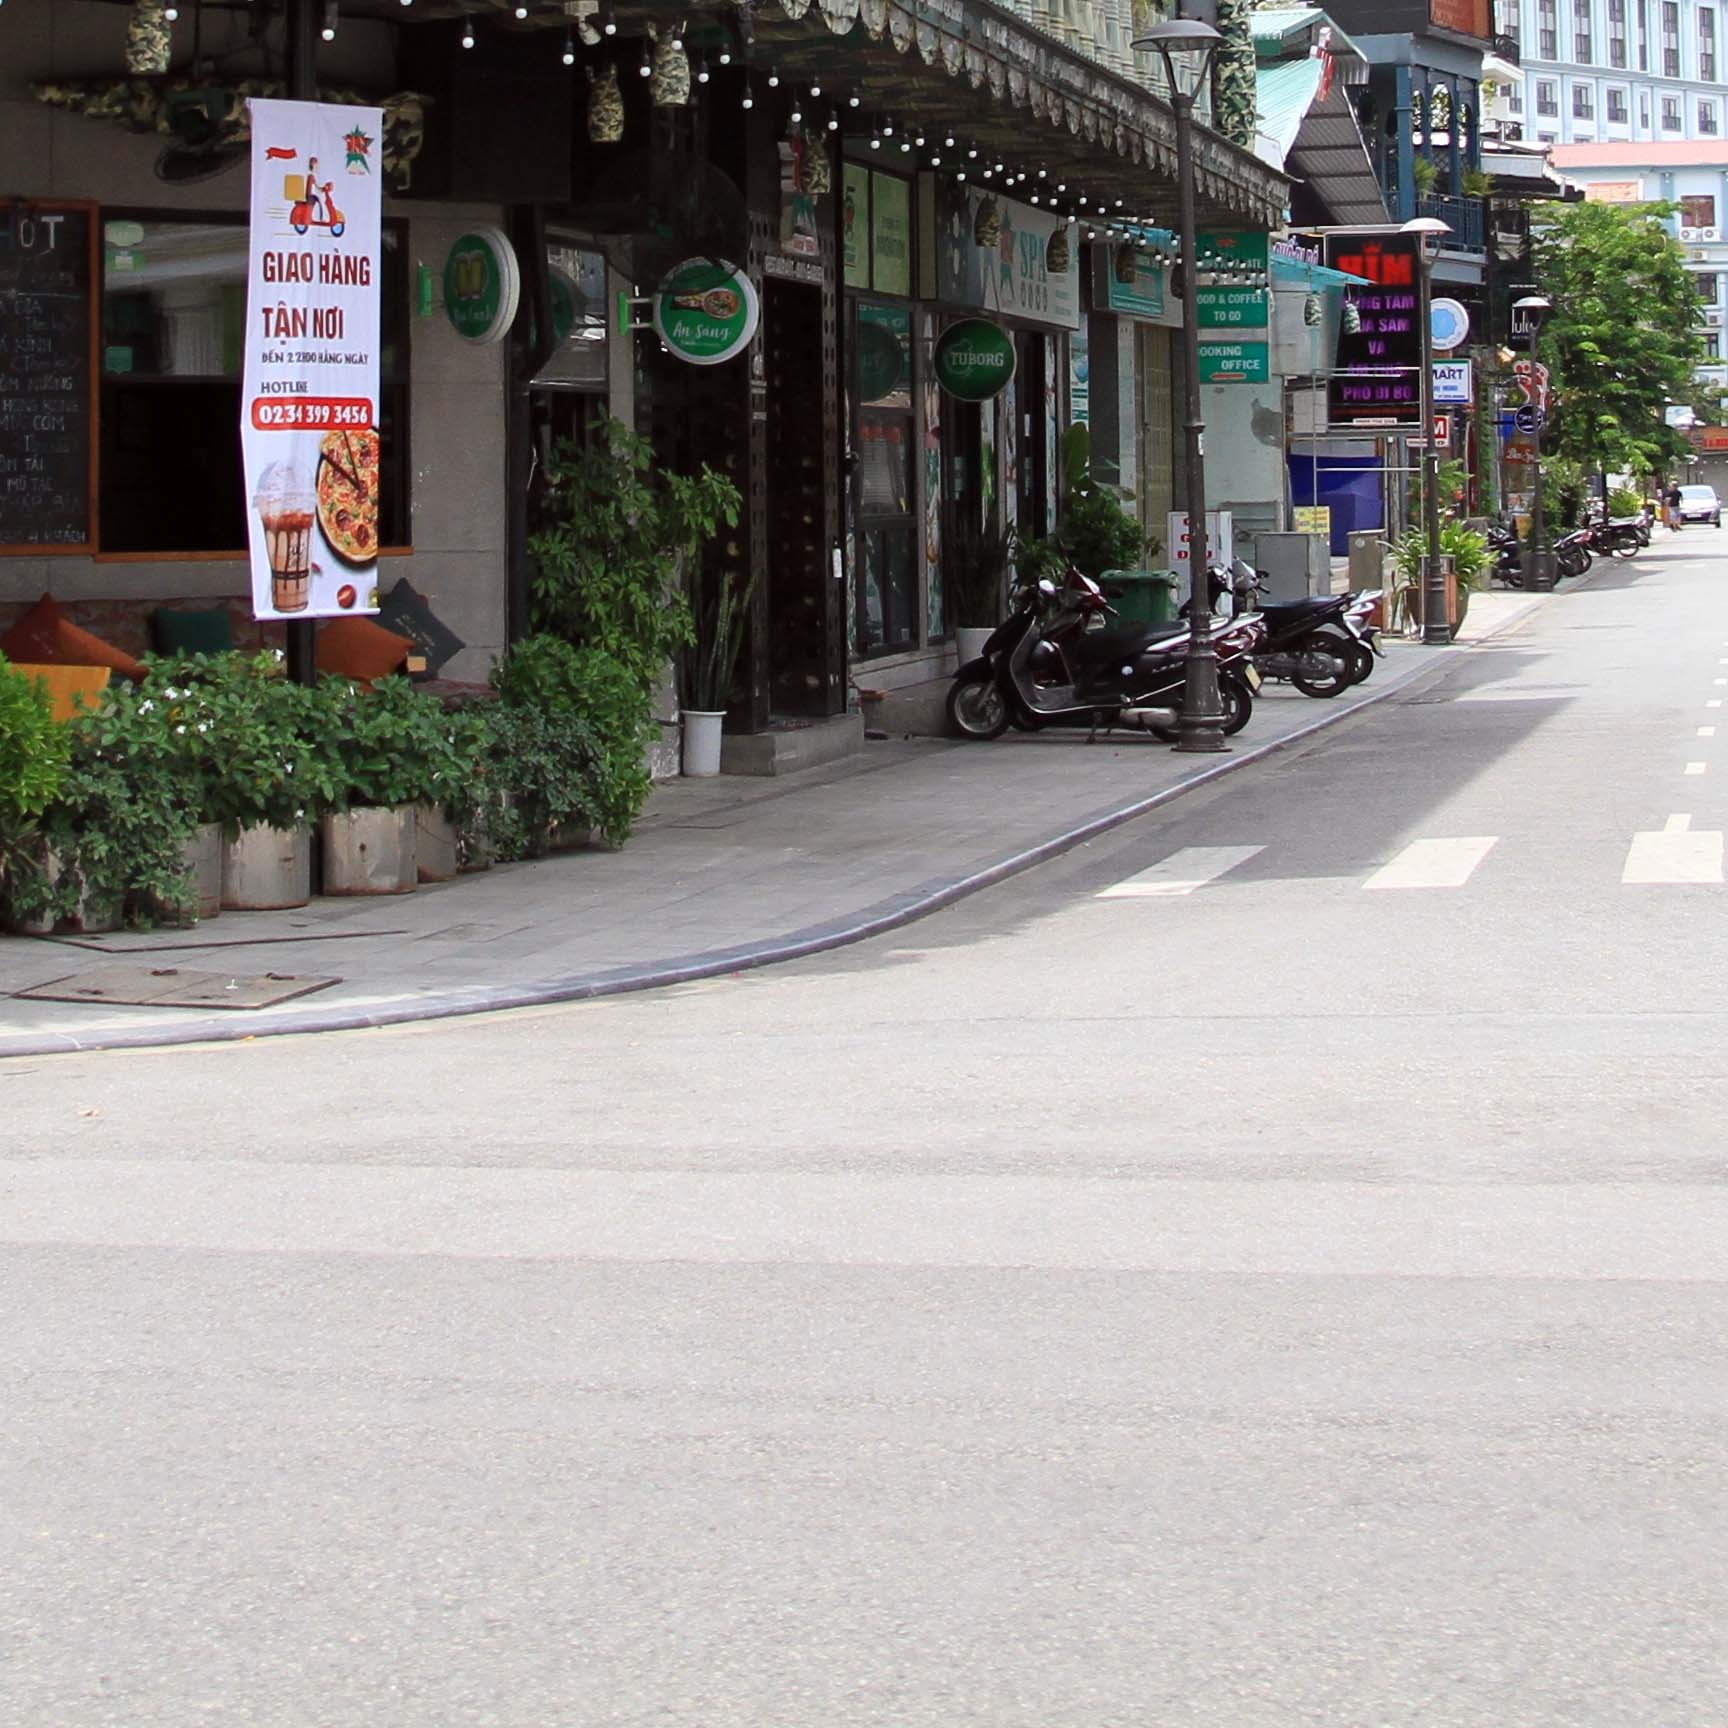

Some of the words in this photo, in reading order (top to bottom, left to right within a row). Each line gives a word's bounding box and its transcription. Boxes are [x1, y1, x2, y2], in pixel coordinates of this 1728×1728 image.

[262, 251, 314, 284] GIAO
[319, 248, 371, 286] HÀNG
[1197, 294, 1216, 305] OOD
[1227, 293, 1264, 305] COFFEE
[262, 300, 308, 346] TẬN
[313, 306, 344, 340] NƠI
[1214, 311, 1226, 321] TO
[1228, 311, 1241, 321] GO
[1199, 346, 1242, 357] OOKING
[952, 351, 1004, 368] TUBORG
[1221, 359, 1261, 370] OFFICE
[259, 405, 303, 424] 0234
[306, 405, 330, 423] 399
[333, 405, 368, 425] 3456
